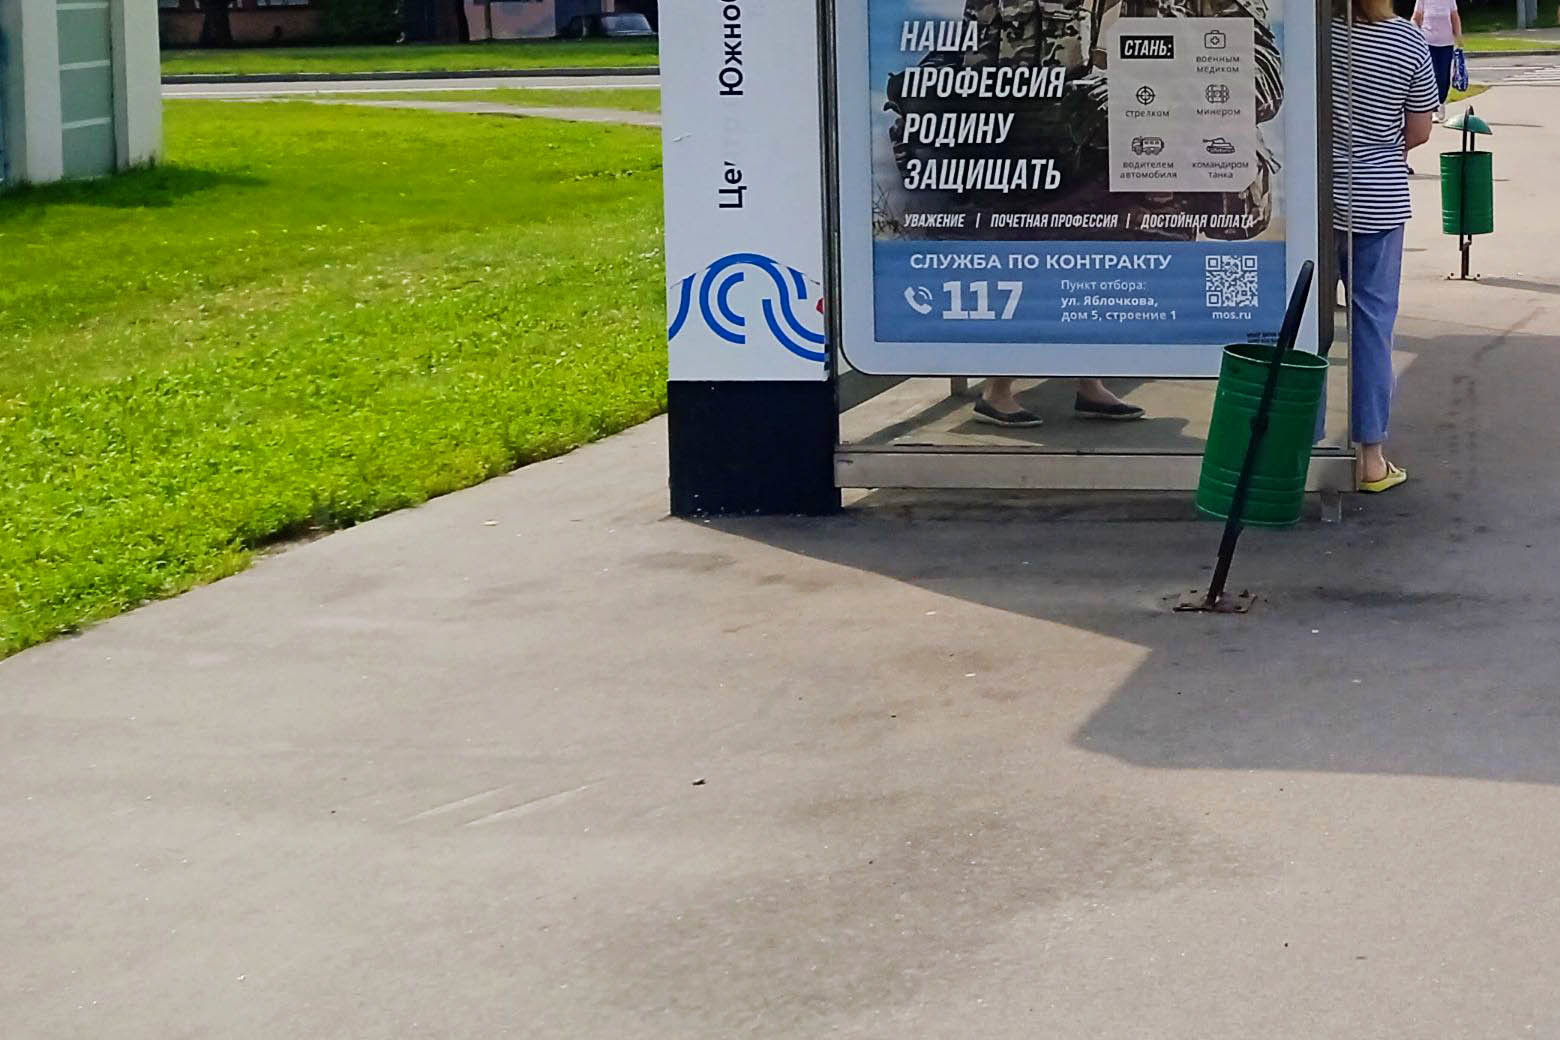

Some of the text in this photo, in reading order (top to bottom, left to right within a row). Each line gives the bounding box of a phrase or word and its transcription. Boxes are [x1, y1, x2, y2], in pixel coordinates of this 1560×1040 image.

[900, 21, 979, 52] НАША
[1124, 39, 1172, 56] СТАНЬ:
[901, 66, 1066, 98] ПРОФЕССИЯ
[902, 112, 1015, 147] РОДИНУ
[1123, 161, 1174, 169] водителем
[1192, 161, 1249, 169] командиром
[903, 158, 1062, 193] ЗАЩИЩАТЬ
[1120, 171, 1177, 179] автомобиля
[904, 213, 966, 228] УВАЖЕНИЕ
[990, 213, 1118, 228] ПОЧЕТНАЯ ПРОФЕССИЯ
[1140, 212, 1254, 229] ДОСТОЙНАЯ ОПЛАТА
[910, 254, 1172, 270] СЛУЖБА ПО КОНТРАКТУ
[1061, 279, 1147, 293] Пункт отбора:
[942, 280, 1023, 320] 117
[1061, 295, 1158, 309] ул. Яблочкова,
[1061, 311, 1088, 321] дом
[1091, 310, 1102, 321] 5,
[1105, 310, 1167, 322] строение
[1212, 311, 1252, 320] mos.ru
